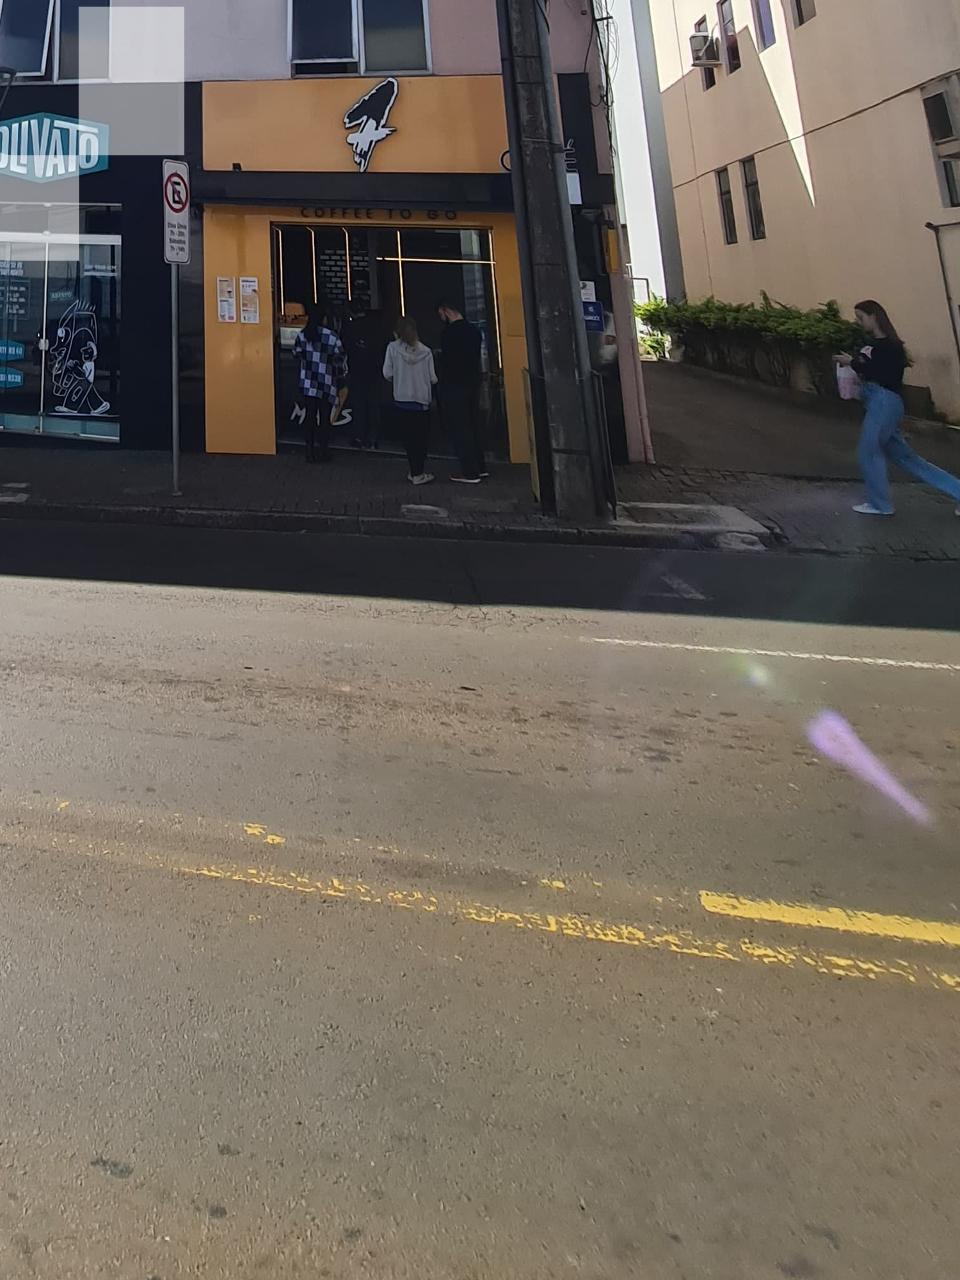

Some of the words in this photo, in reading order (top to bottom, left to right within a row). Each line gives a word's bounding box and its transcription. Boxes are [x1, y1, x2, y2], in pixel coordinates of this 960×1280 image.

[300, 207, 374, 219] COFFEE
[386, 209, 412, 220] TO
[426, 209, 457, 221] GO
